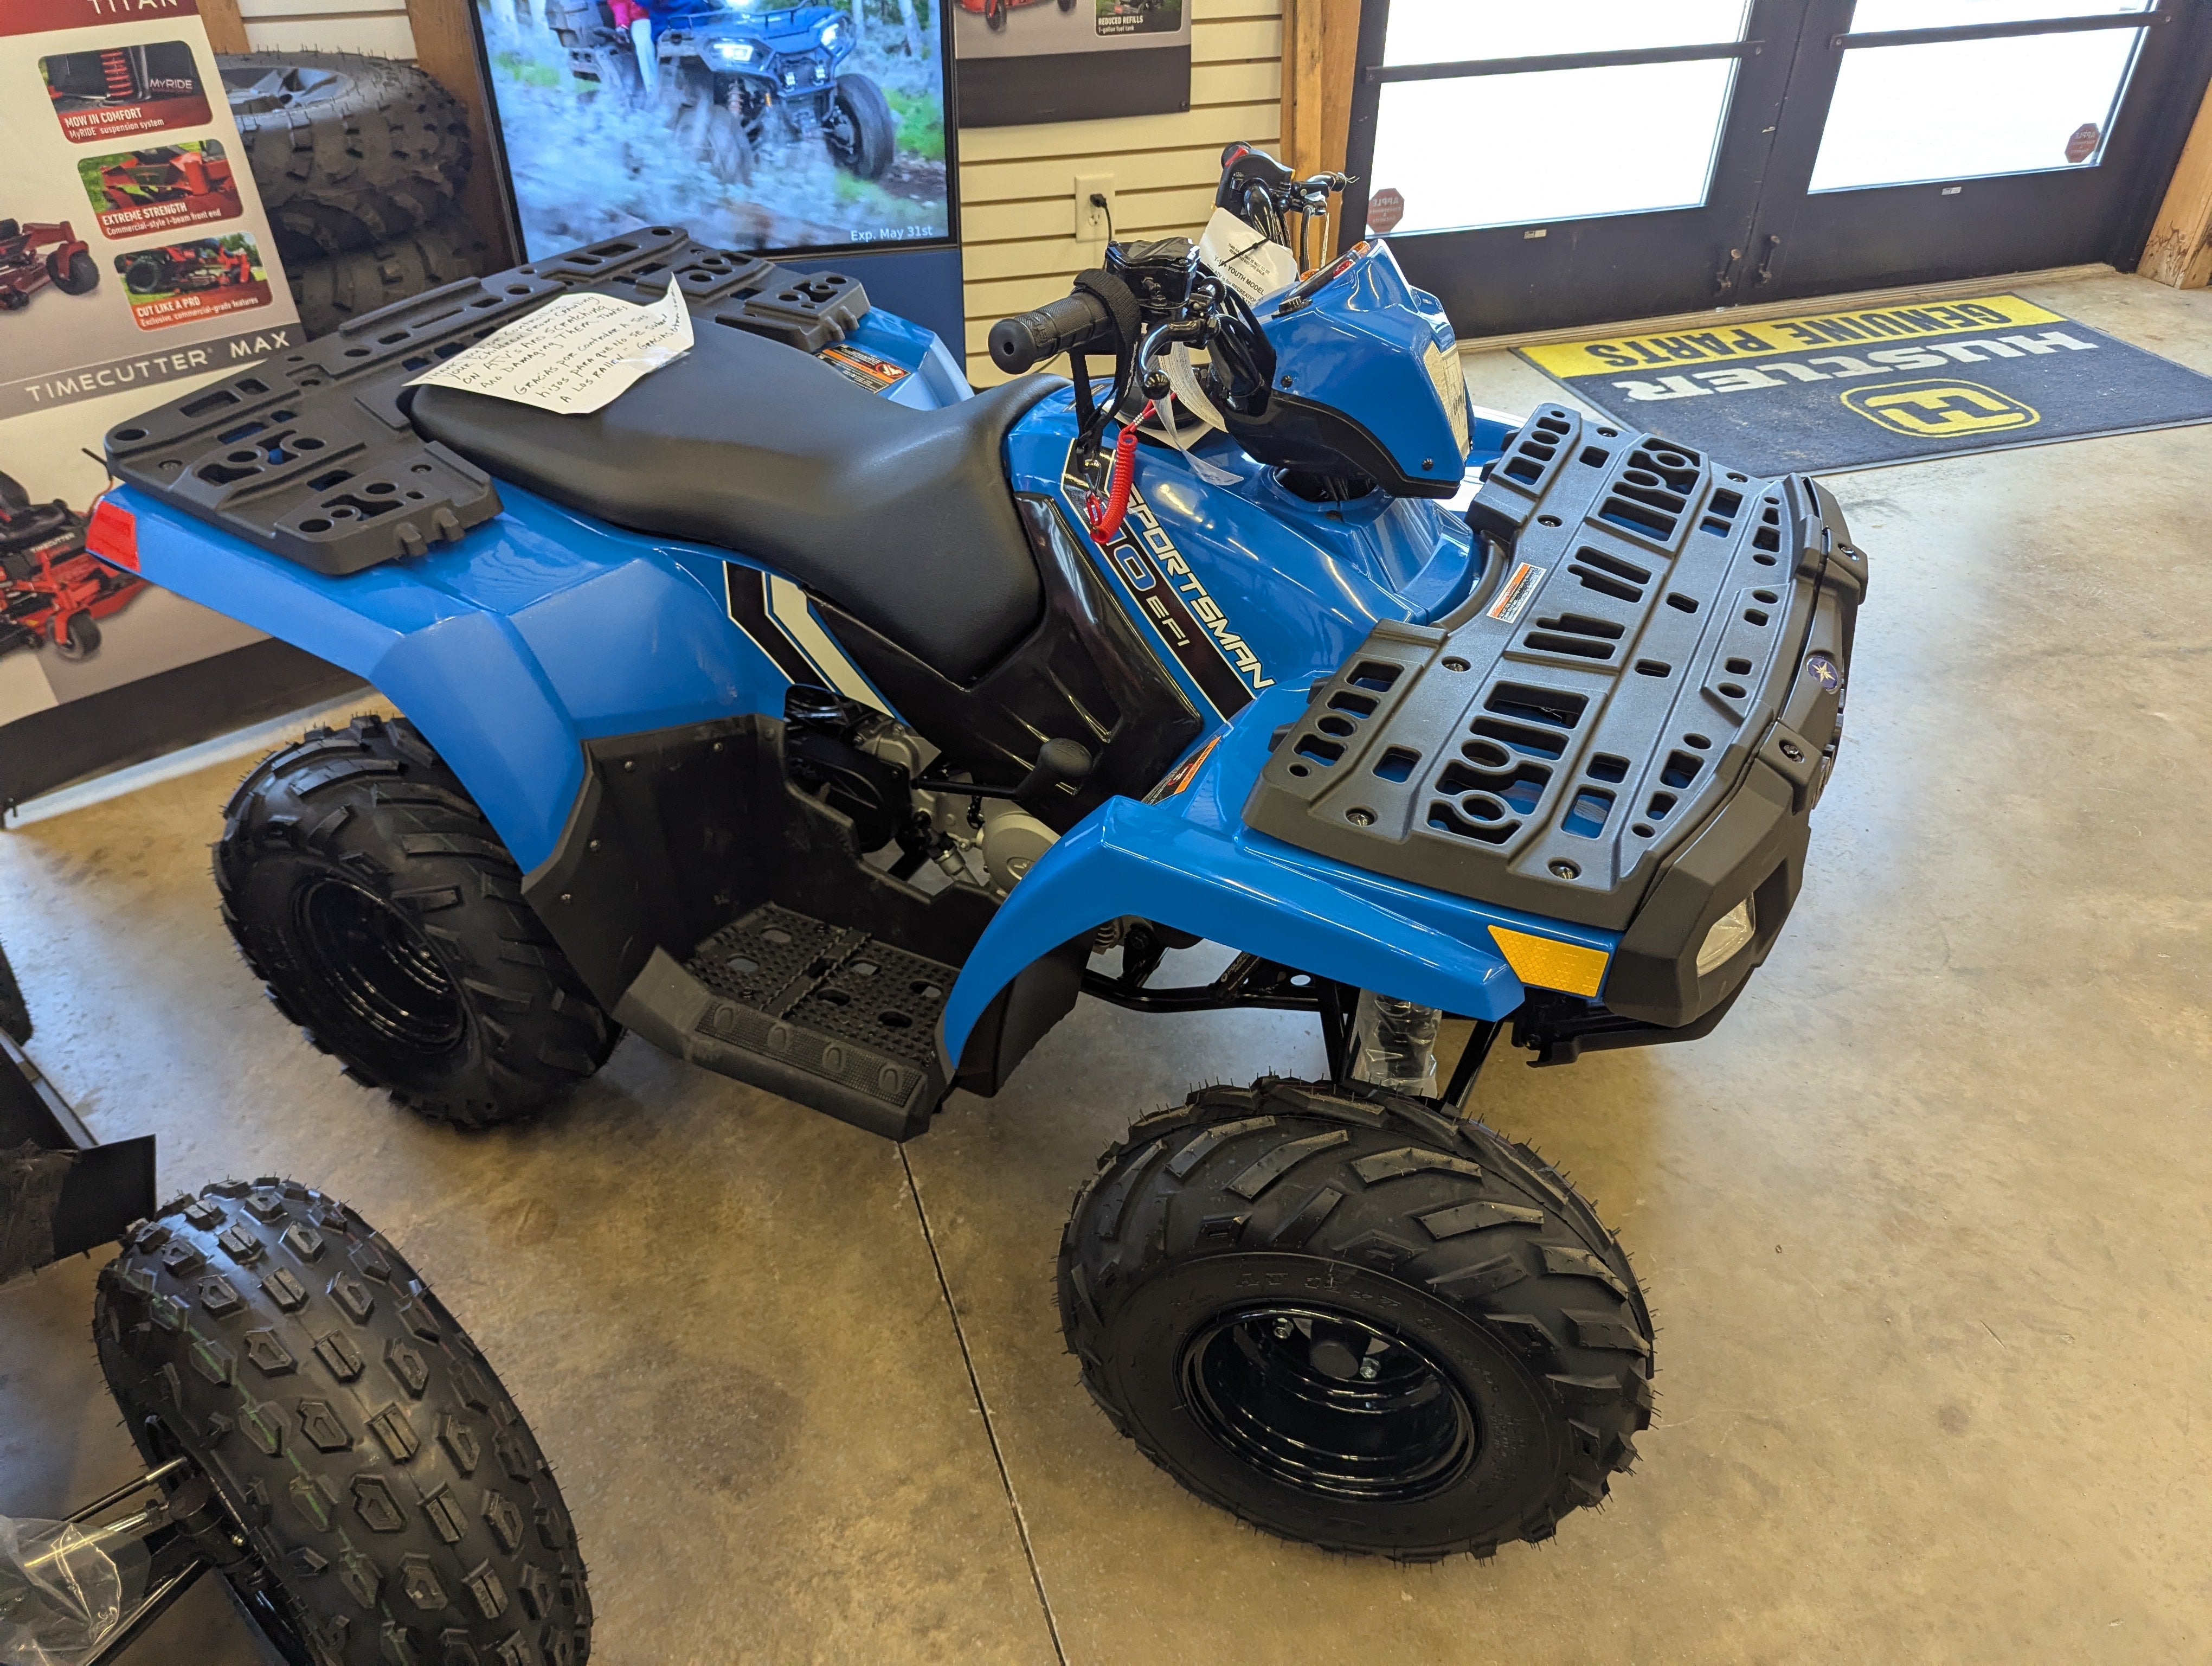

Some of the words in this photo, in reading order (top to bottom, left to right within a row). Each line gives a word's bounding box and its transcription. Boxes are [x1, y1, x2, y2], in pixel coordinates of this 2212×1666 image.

[1098, 17, 1122, 25] REDUCED
[1123, 15, 1143, 23] REFILLS
[64, 114, 88, 129] MOW
[88, 114, 100, 125] IN
[101, 108, 143, 122] COMFORT
[100, 120, 139, 135] suspension
[140, 118, 164, 130] system
[102, 209, 143, 226] EXTREME
[144, 202, 188, 219] STRENGTH
[106, 219, 165, 236] Commercial-style
[850, 230, 876, 242] Exp.
[879, 228, 904, 241] May
[907, 226, 933, 237] 31st
[1227, 265, 1246, 282] YOUTH
[1245, 278, 1265, 296] MODEL
[137, 306, 154, 318] CUT
[155, 302, 175, 315] LIKE
[175, 299, 182, 309] A
[182, 296, 201, 307] PRO
[1771, 303, 2012, 345] GENUINE
[1584, 328, 1777, 367] PARTS
[25, 349, 209, 402] TIMECUTTER
[229, 331, 291, 358] MAX
[1611, 331, 2099, 401] HUSTLER
[1127, 482, 1275, 689] SPORTSMAN
[1146, 595, 1191, 647] EFI
